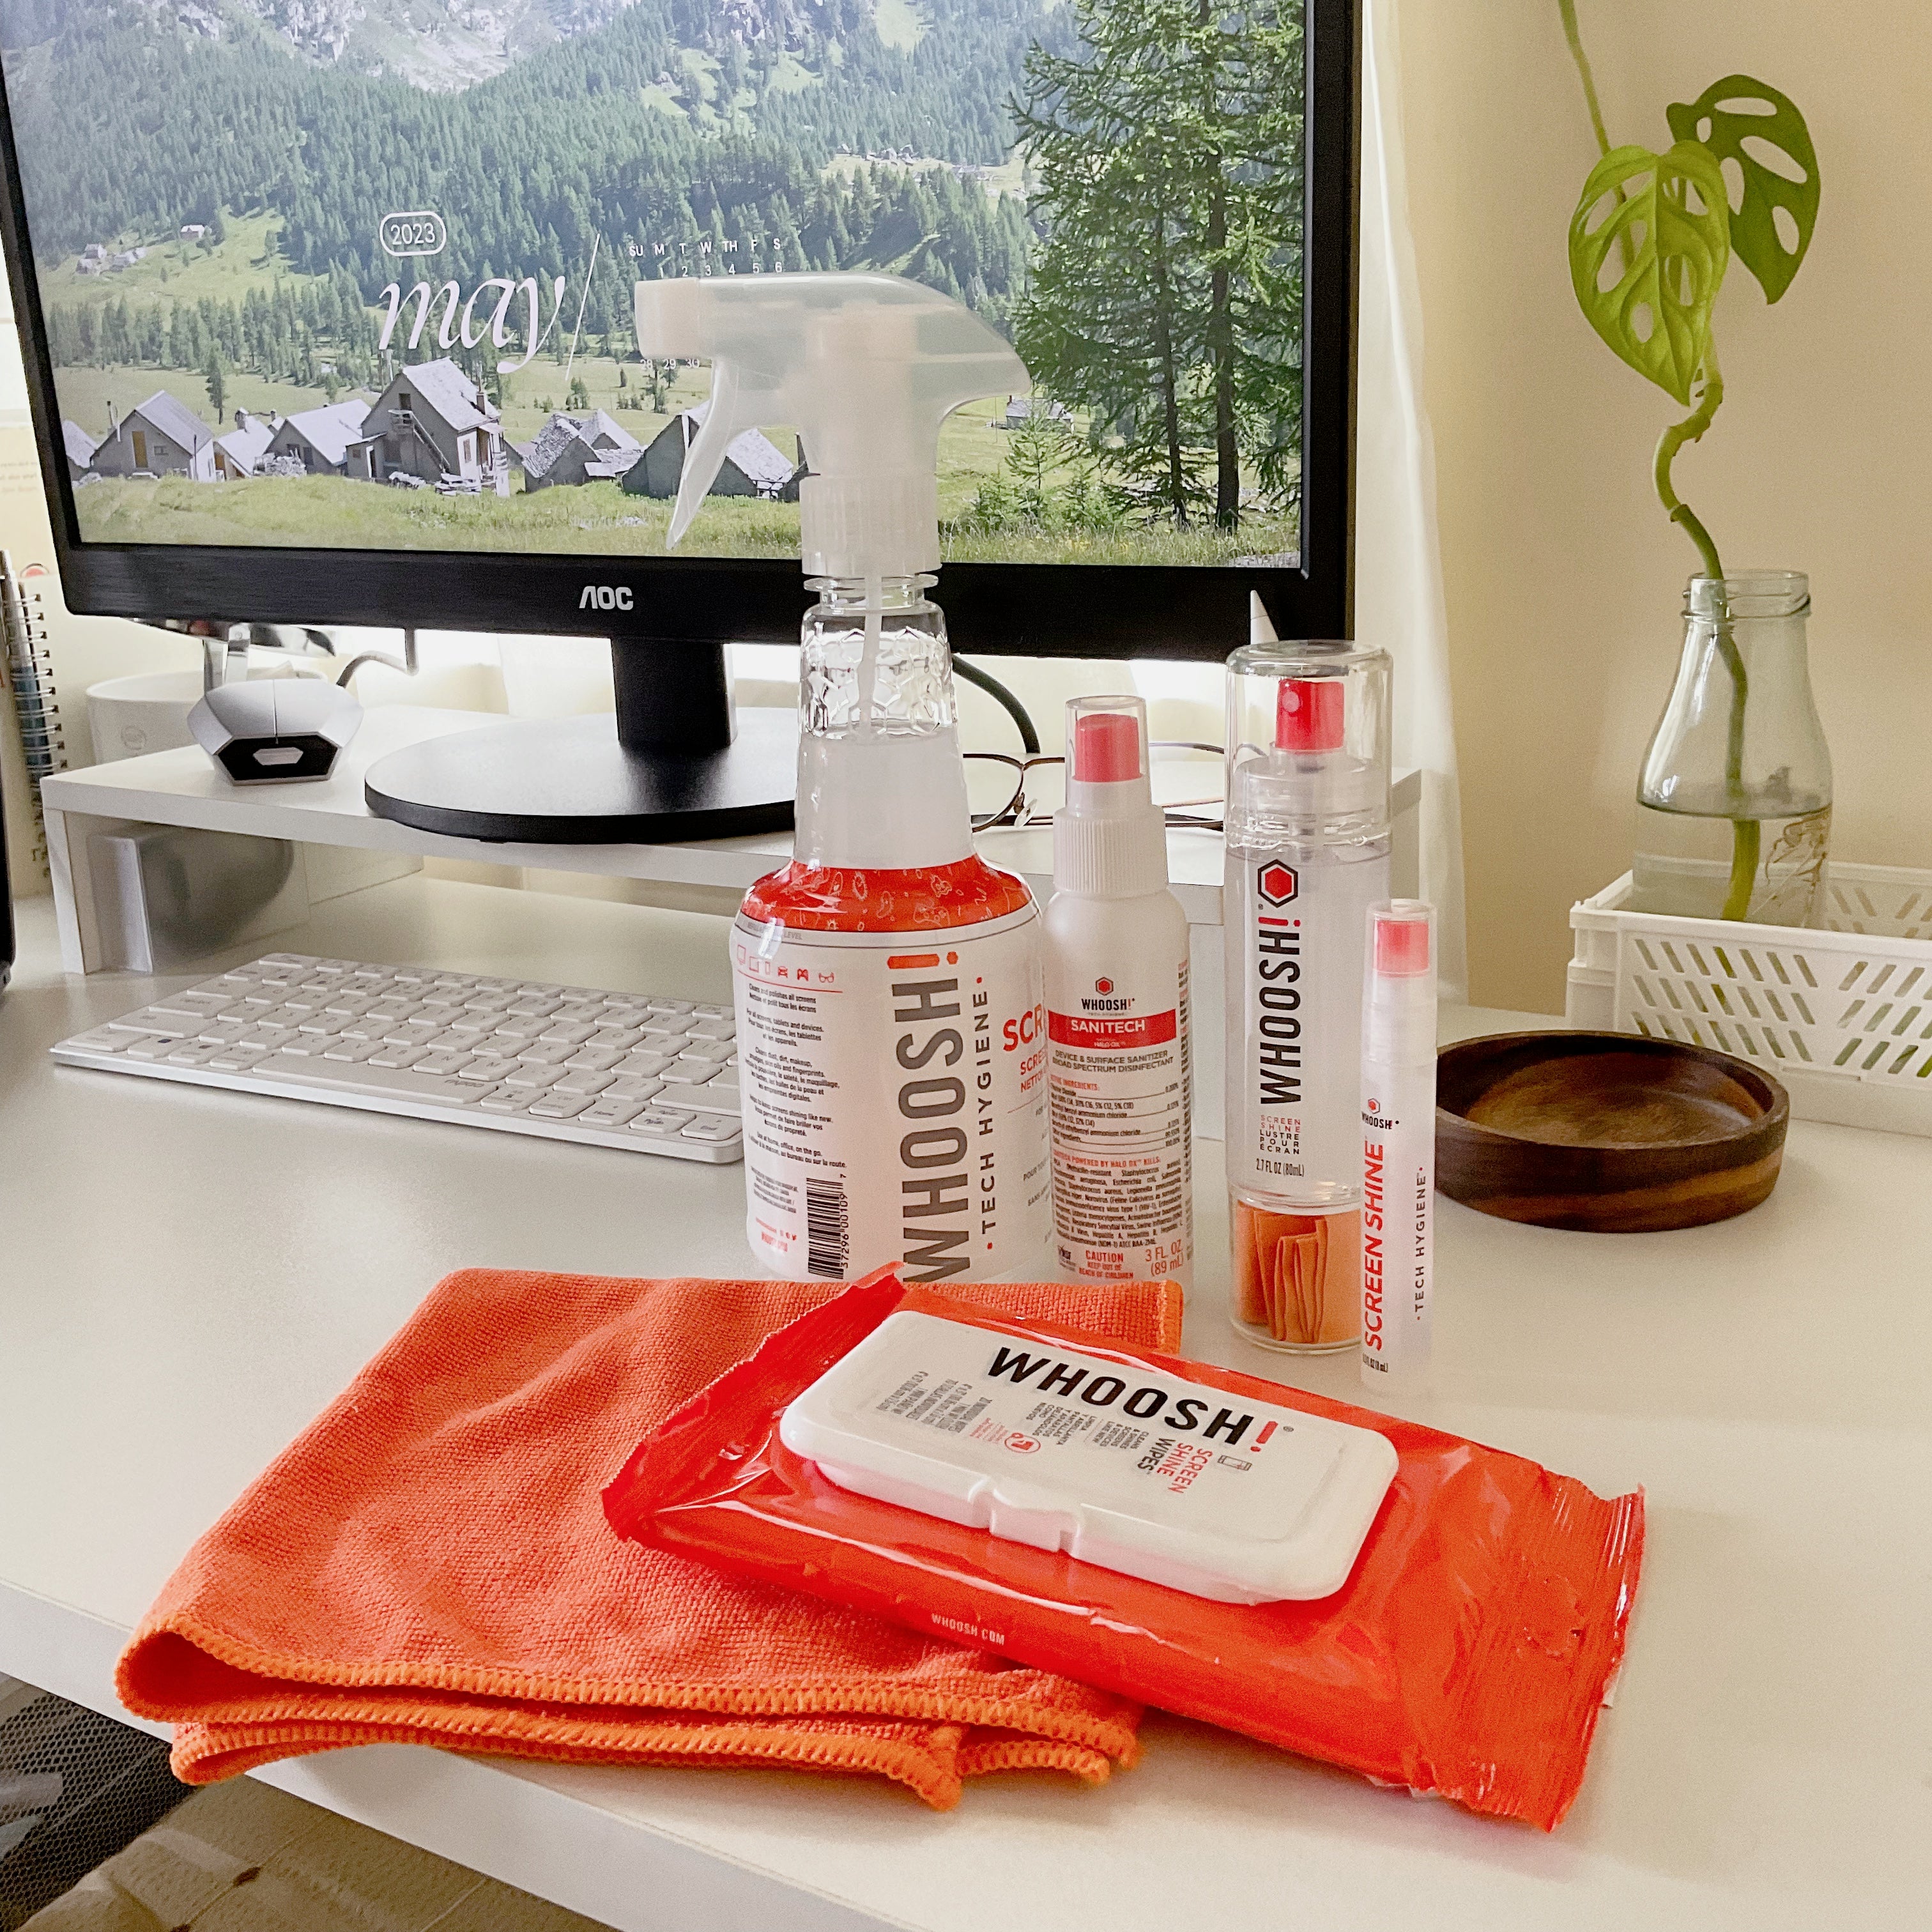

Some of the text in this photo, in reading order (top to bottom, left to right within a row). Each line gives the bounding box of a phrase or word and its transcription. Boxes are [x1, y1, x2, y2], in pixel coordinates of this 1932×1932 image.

[390, 222, 436, 246] 2023
[654, 243, 664, 256] M
[679, 243, 686, 254] T
[700, 241, 712, 254] W
[723, 240, 738, 252] TH
[751, 239, 758, 251] F
[773, 238, 781, 250] S
[681, 265, 688, 277] 2
[705, 264, 712, 276] 3
[728, 264, 736, 275] 4
[753, 263, 760, 273] 5
[775, 261, 782, 273] 6
[379, 276, 566, 374] may
[579, 585, 634, 611] AOC
[1081, 998, 1131, 1010] WHOOSH!
[1257, 916, 1301, 1105] WHOOSH!
[1071, 1020, 1146, 1034] SANITECH
[1055, 1050, 1078, 1062] DEVICE
[1087, 1054, 1126, 1064] SURFACE
[1128, 1050, 1168, 1063] SANITIZER
[1073, 1064, 1116, 1073] SPECTRUM
[1118, 1056, 1174, 1073] DISINFECTANT
[887, 951, 970, 1282] WHOOSH!
[973, 991, 997, 1234] TECH HYGIENE
[1261, 1114, 1301, 1125] SCREEN
[1259, 1129, 1300, 1140] LUSTRE
[1261, 1122, 1301, 1133] SHINE
[1260, 1136, 1300, 1148] POUR
[1274, 1162, 1282, 1174] OZ
[1365, 1140, 1384, 1231] SHINE
[839, 1193, 849, 1229] 00109
[1145, 1248, 1152, 1262] 3
[1170, 1238, 1182, 1255] OZ
[1414, 1174, 1427, 1313] TECH HYGIENE
[1085, 1250, 1124, 1263] CAUTION
[1151, 1260, 1167, 1277] (89
[1365, 1235, 1384, 1352] SCREEN
[986, 1346, 1279, 1453] WHOOSH!
[1137, 1438, 1176, 1471] WIPES
[1156, 1443, 1194, 1477] SHINE
[1167, 1448, 1213, 1494] SCREEN
